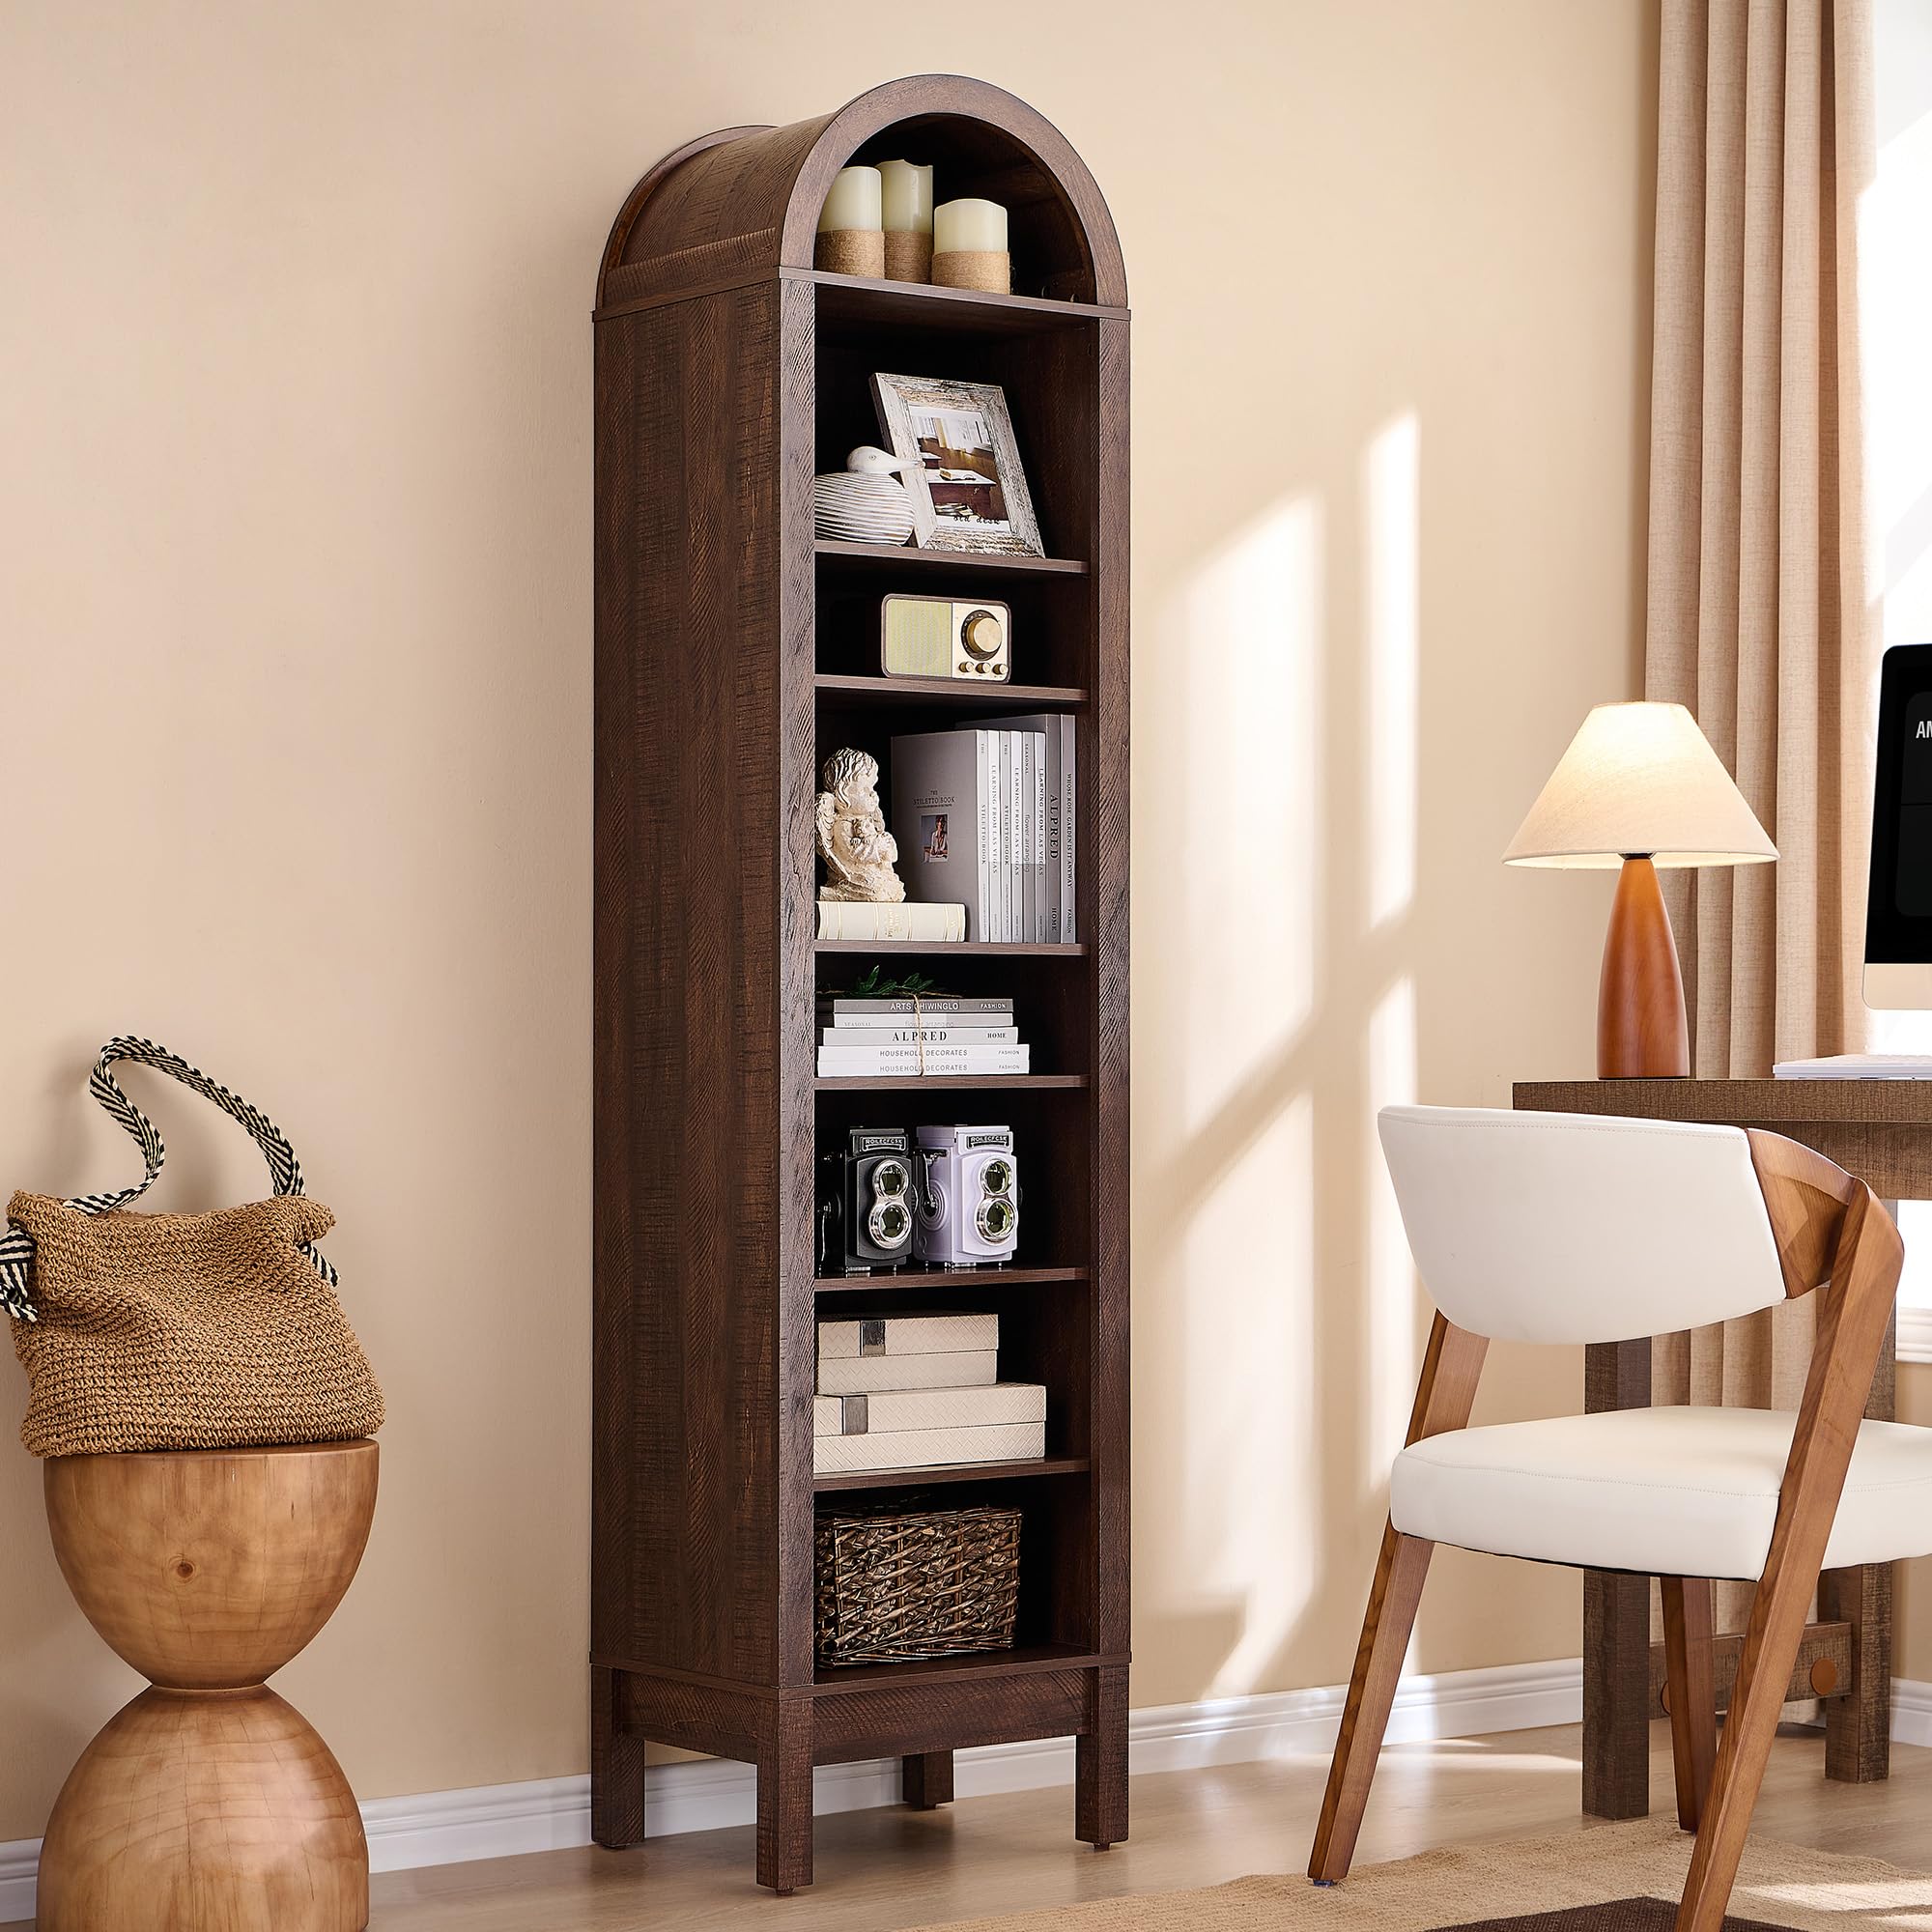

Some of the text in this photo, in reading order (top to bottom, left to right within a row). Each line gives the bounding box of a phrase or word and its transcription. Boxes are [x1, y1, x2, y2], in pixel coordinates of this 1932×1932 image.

[1050, 794, 1059, 859] ALPRED
[890, 1002, 912, 1010] ARTS
[892, 1031, 947, 1041] ALPRED
